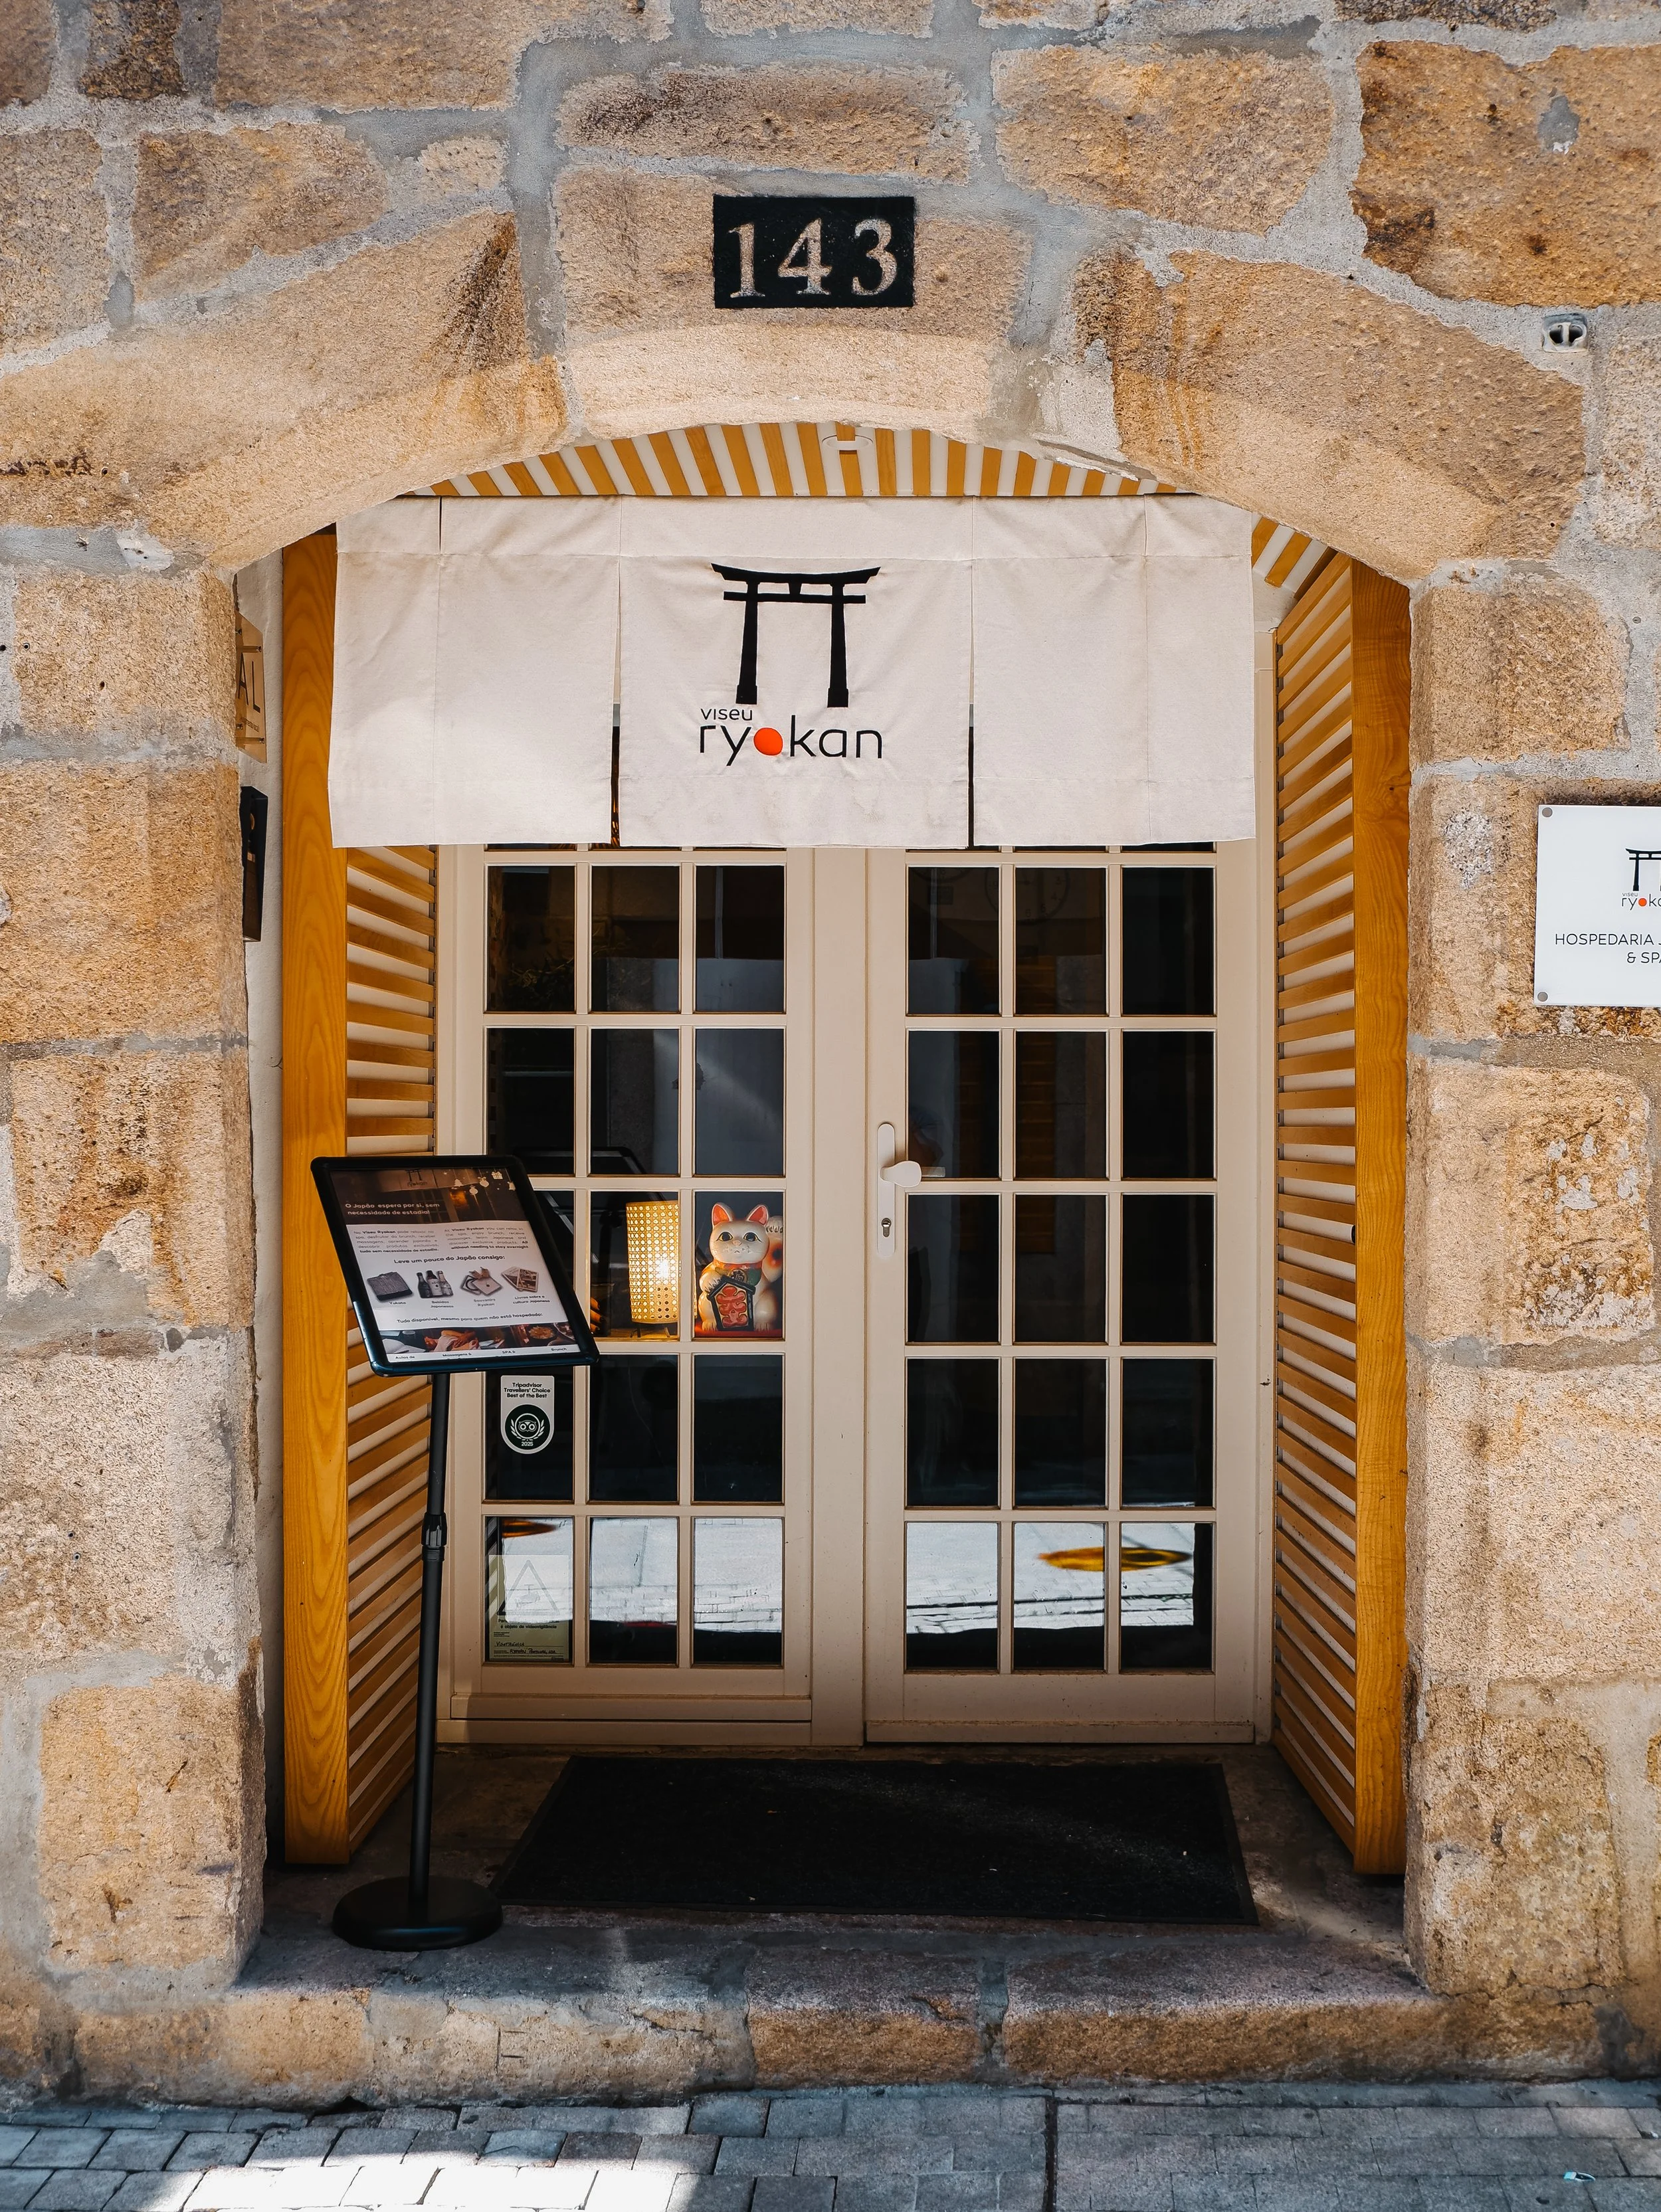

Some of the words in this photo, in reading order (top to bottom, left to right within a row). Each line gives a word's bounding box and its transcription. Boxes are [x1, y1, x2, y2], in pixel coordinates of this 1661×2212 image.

[729, 217, 897, 298] 143
[238, 652, 260, 713] AL
[701, 708, 753, 721] viseu
[700, 714, 882, 767] ryokan
[1555, 933, 1654, 945] HOSPEDARIA
[1626, 952, 1636, 964] &
[1640, 952, 1661, 964] SP
